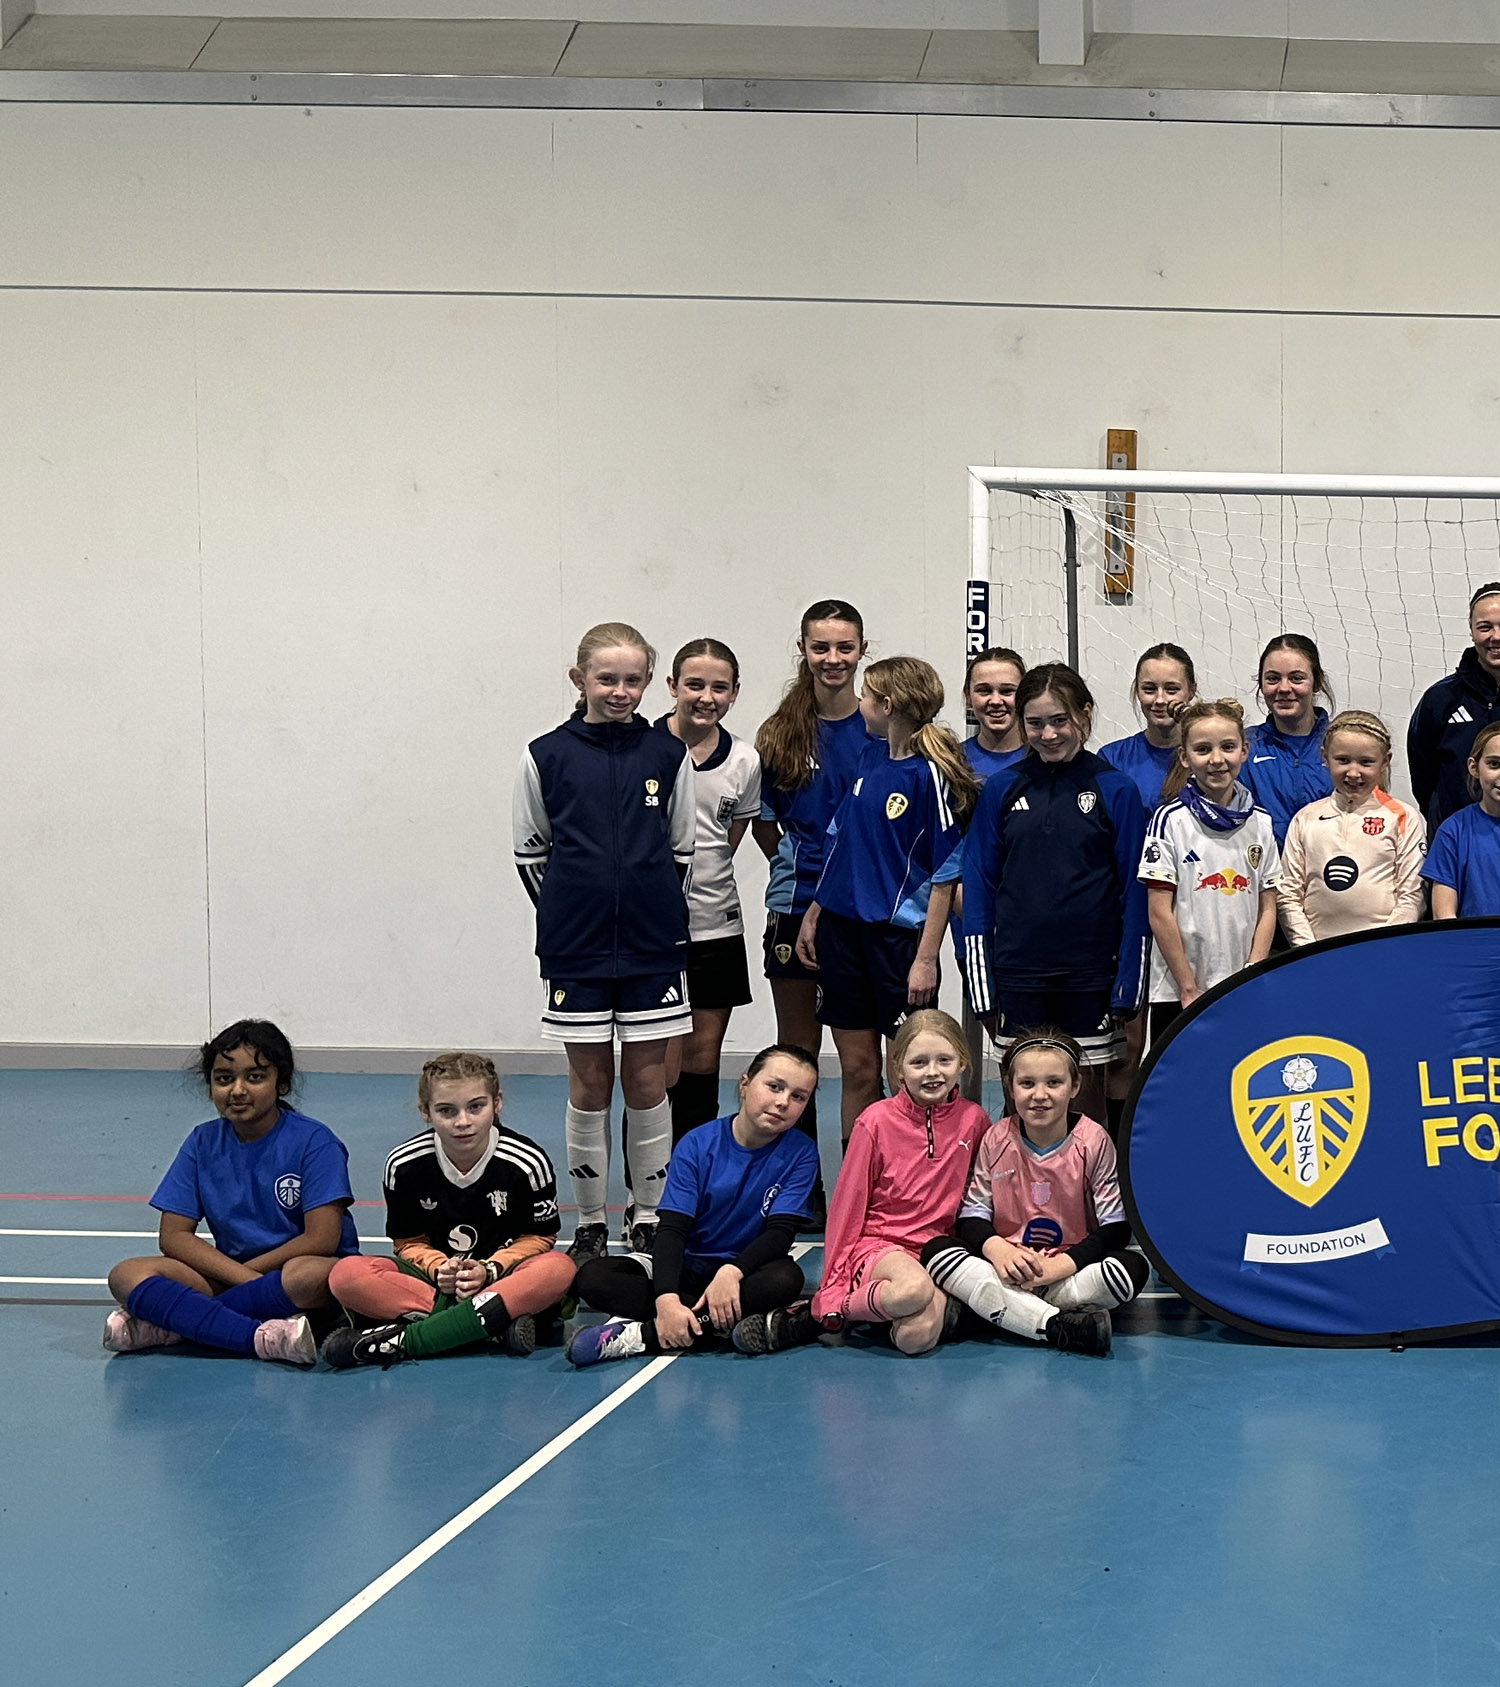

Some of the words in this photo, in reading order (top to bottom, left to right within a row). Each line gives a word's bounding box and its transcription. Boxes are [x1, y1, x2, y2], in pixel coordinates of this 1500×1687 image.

[967, 587, 986, 660] FOR
[645, 795, 659, 806] SB
[1266, 1233, 1366, 1255] FOUNDATION
